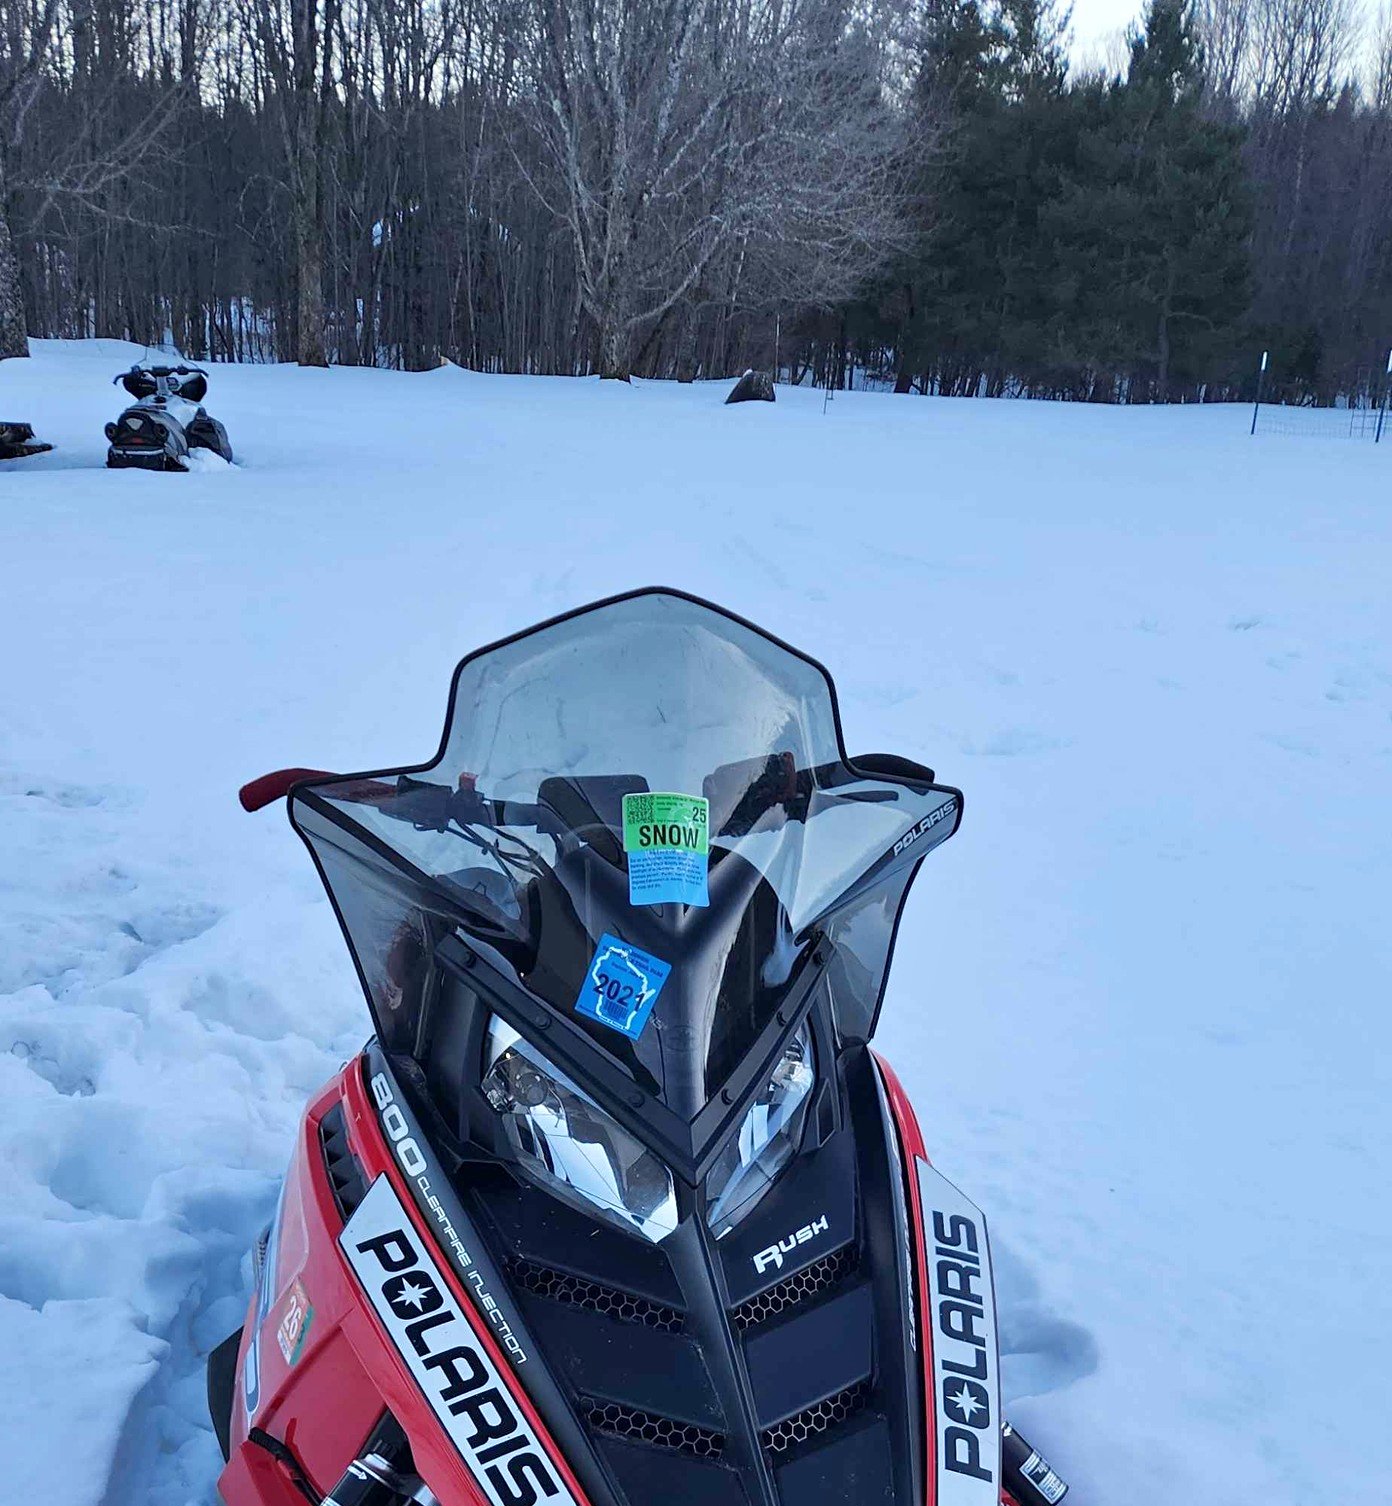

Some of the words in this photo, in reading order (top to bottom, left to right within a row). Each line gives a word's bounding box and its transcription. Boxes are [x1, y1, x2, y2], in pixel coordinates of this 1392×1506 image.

[639, 824, 699, 849] SNOW
[692, 806, 707, 823] 25
[892, 801, 955, 856] POLARIS
[593, 974, 646, 1012] 2021
[371, 1072, 427, 1177] 800
[417, 1176, 472, 1267] CLEANFIRE
[467, 1270, 527, 1364] INJECTION
[283, 1295, 302, 1340] 26
[932, 1211, 993, 1482] POLARIS
